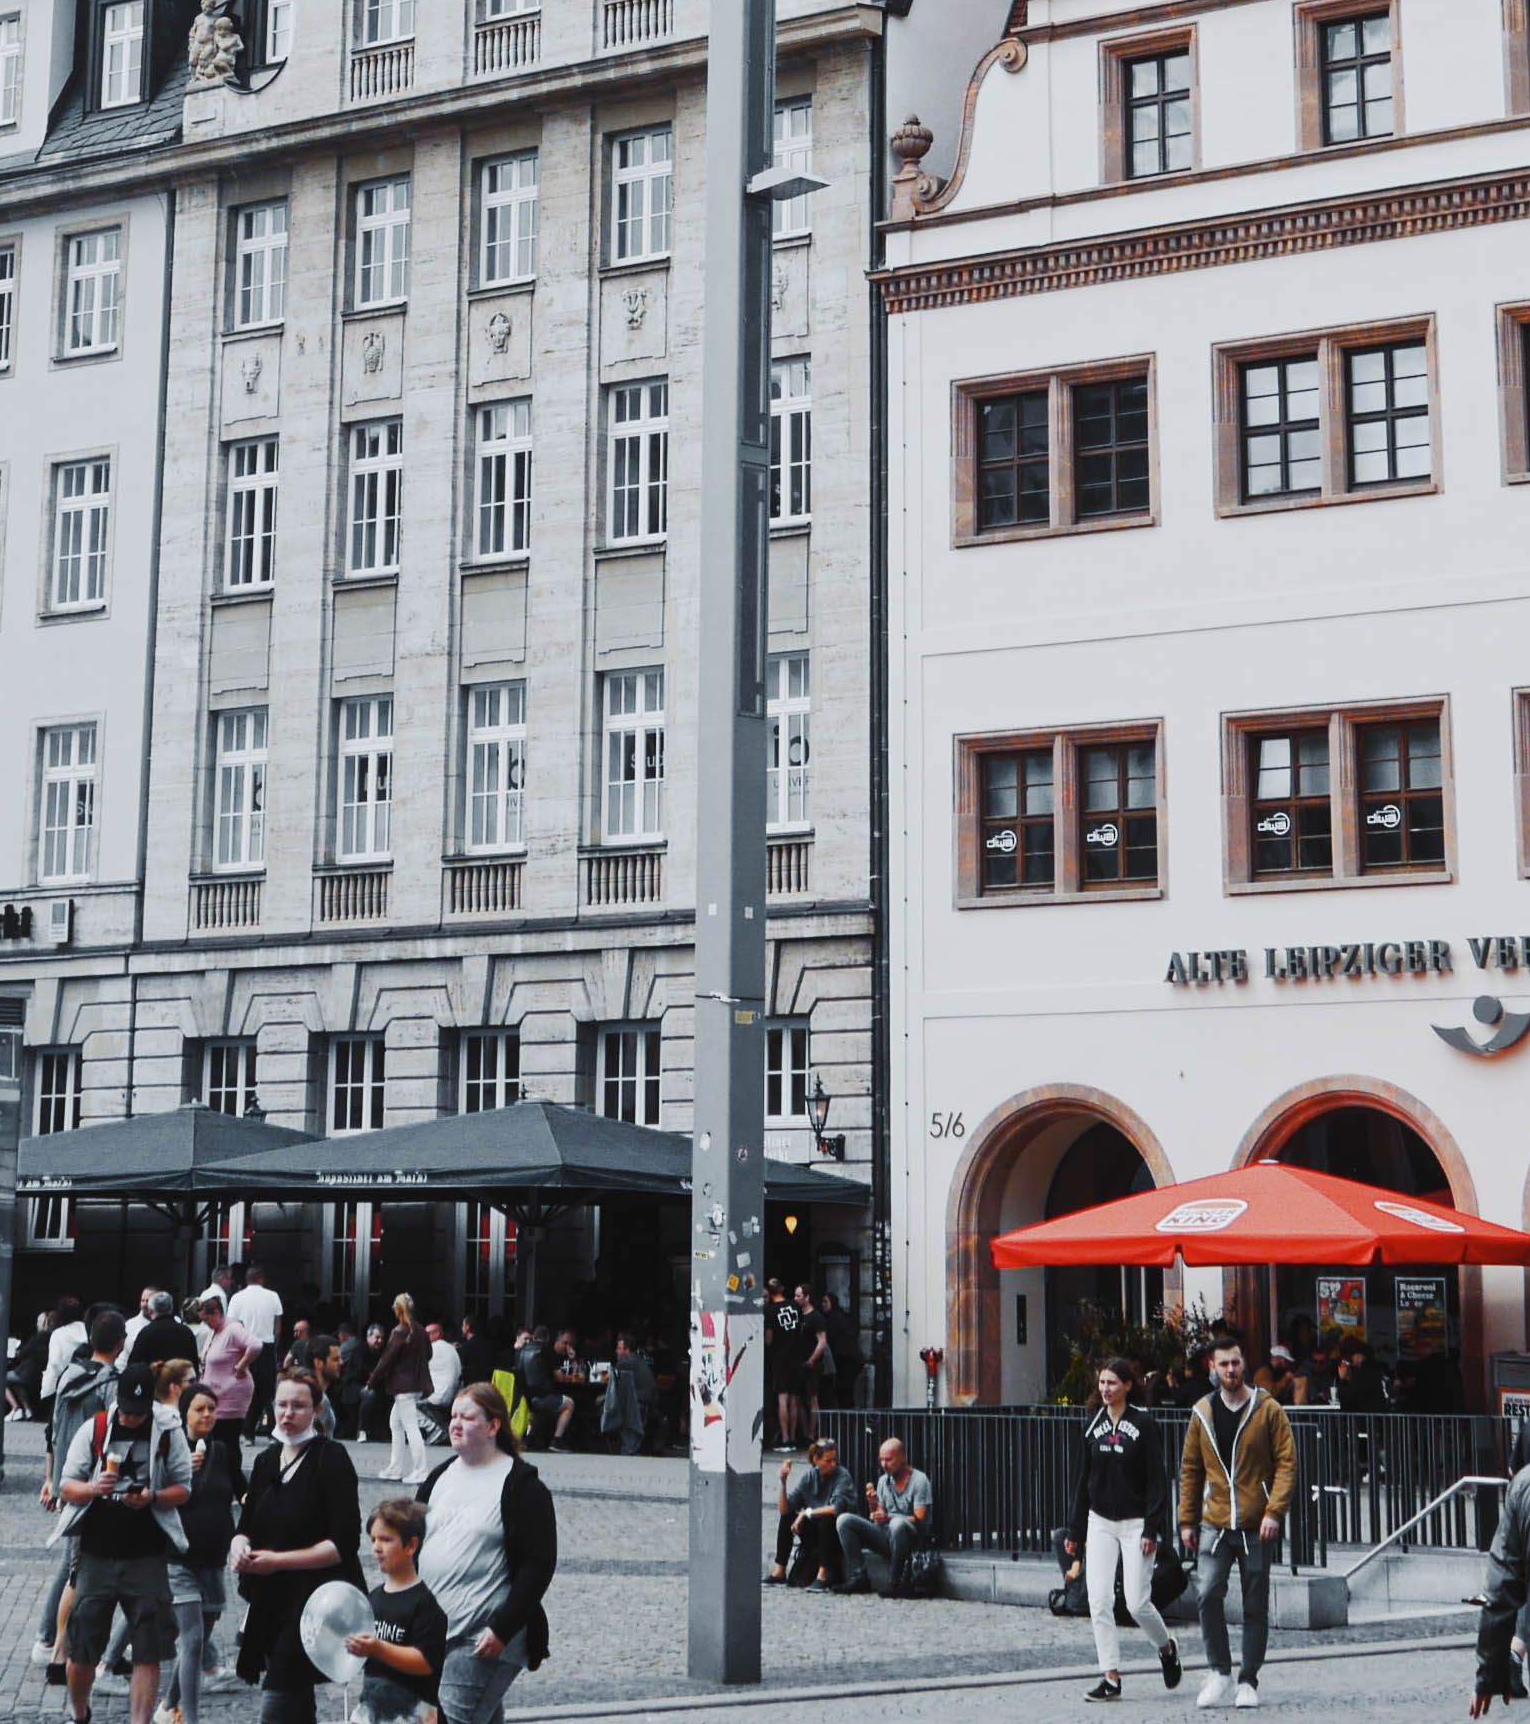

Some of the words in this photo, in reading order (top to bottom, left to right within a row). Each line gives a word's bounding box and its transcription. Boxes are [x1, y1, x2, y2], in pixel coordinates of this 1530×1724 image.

[1163, 949, 1249, 983] ALTE
[1263, 939, 1454, 980] LEIPZIGER
[929, 1111, 966, 1139] 5/6
